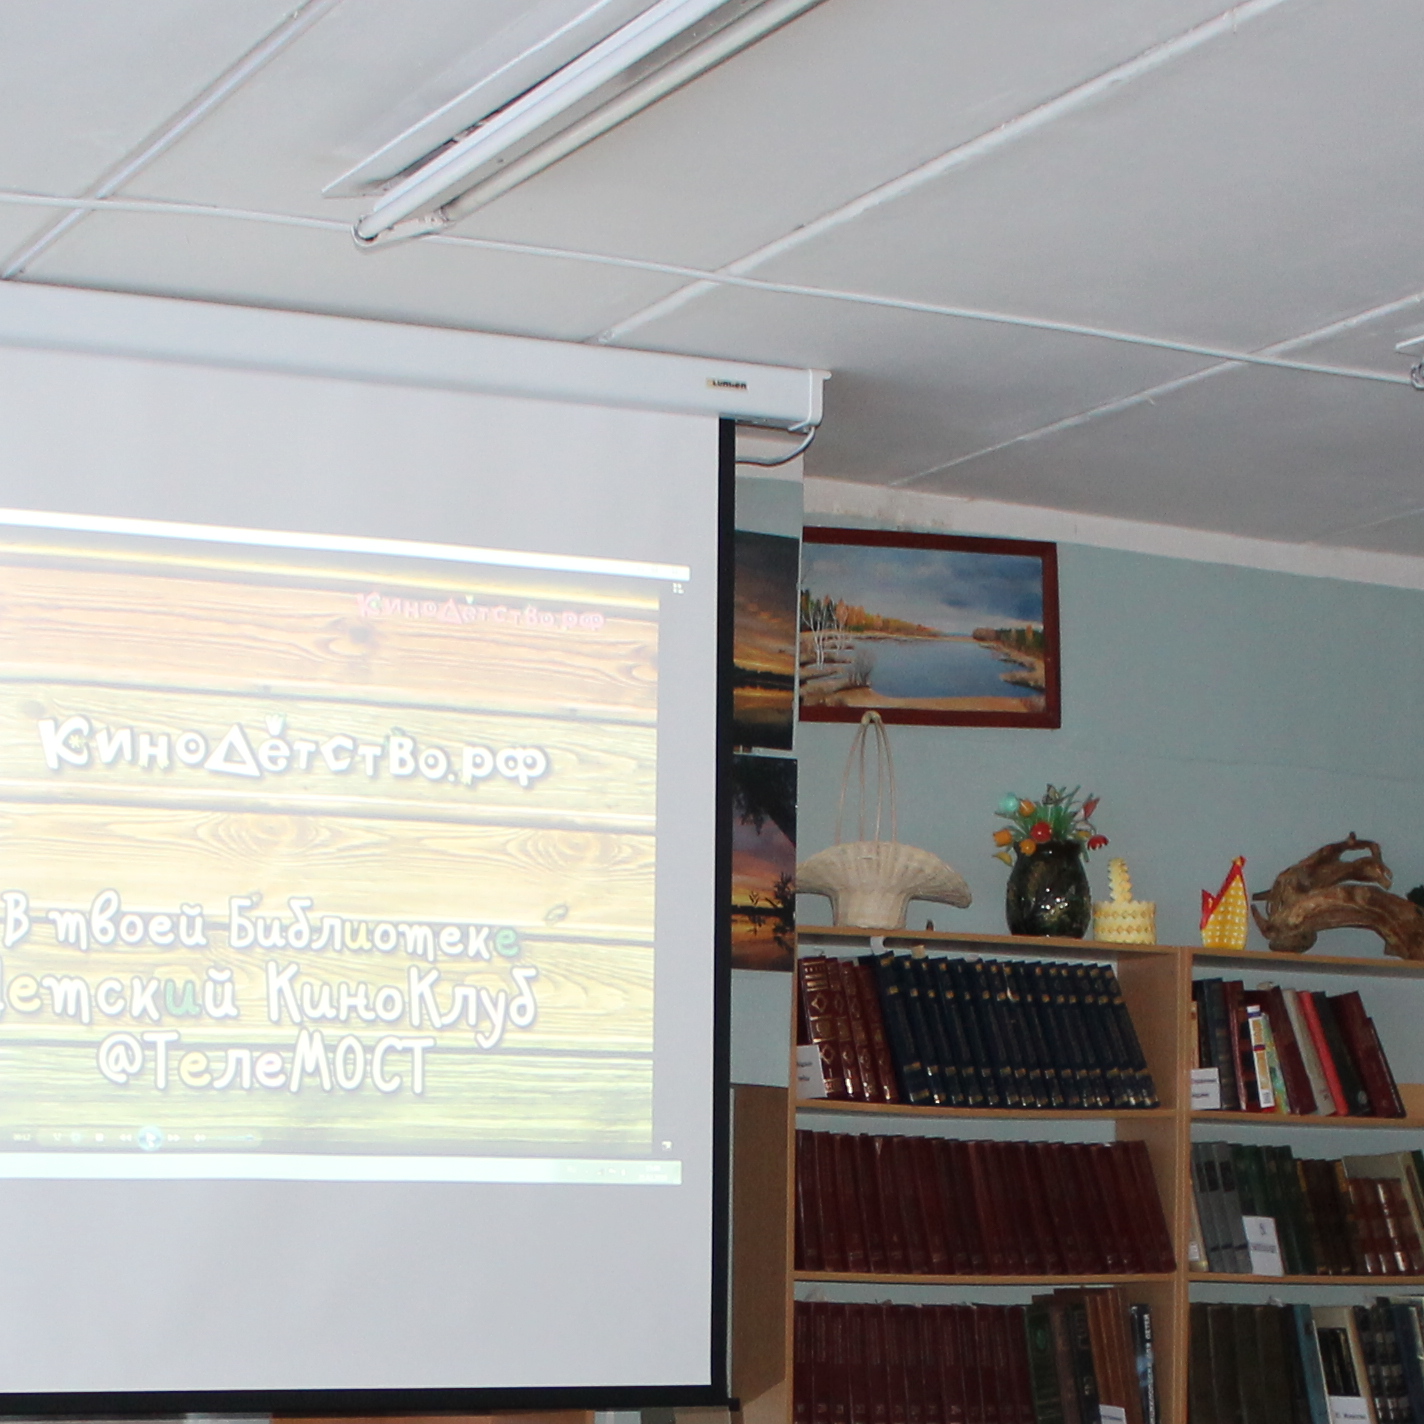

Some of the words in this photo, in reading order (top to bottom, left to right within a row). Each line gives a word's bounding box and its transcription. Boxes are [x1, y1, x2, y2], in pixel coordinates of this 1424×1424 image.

[1, 889, 30, 947] В
[47, 888, 206, 951] твоей
[228, 891, 521, 962] Библиотеке
[266, 959, 539, 1049] КиноКлуб
[96, 1027, 436, 1095] @ТелеМОСТ
